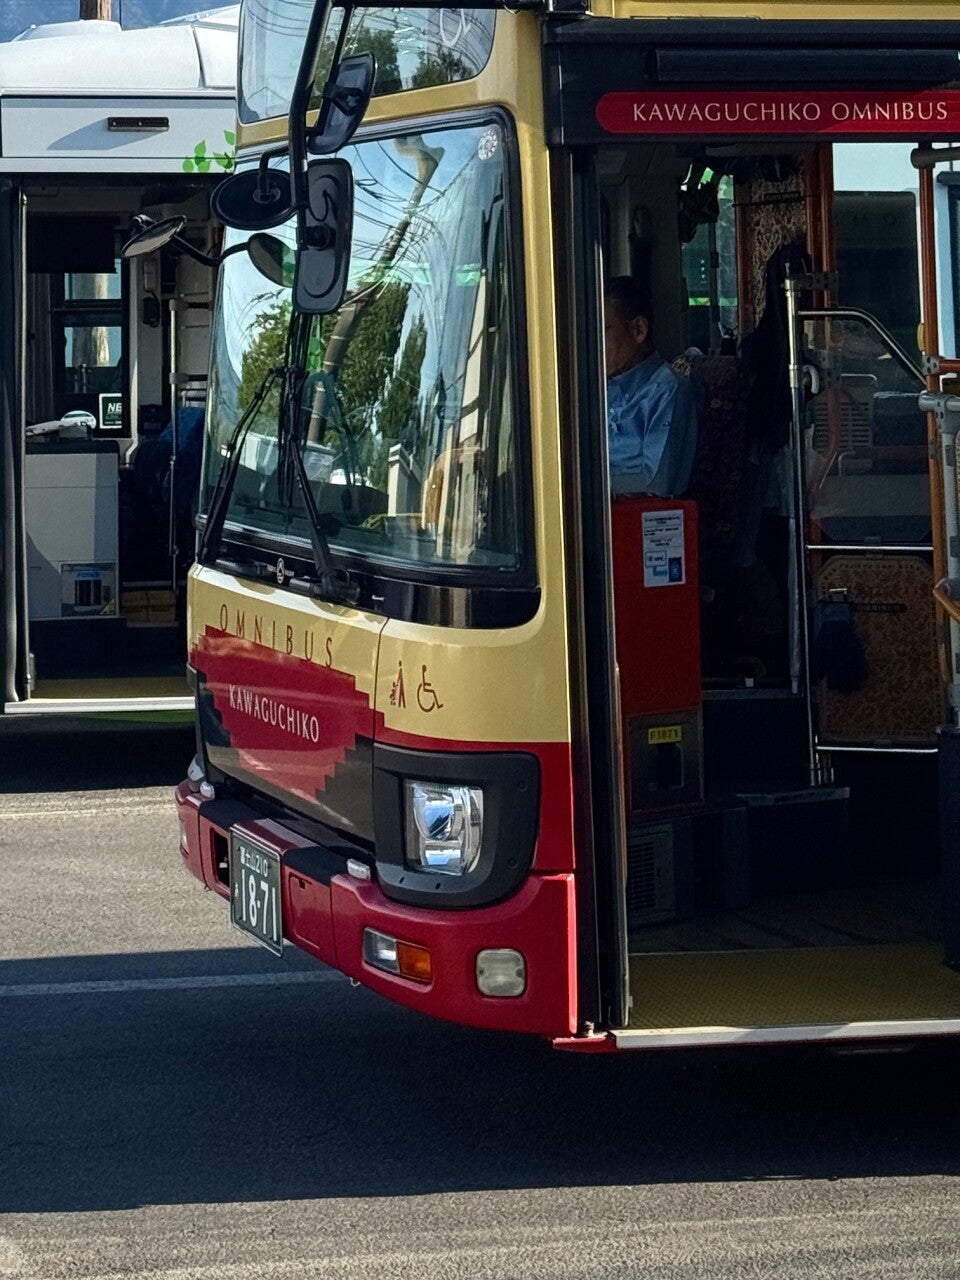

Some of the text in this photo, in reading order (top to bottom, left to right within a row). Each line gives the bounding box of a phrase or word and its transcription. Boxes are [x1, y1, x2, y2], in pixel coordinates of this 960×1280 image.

[633, 101, 948, 122] KAWAGUCHIKO OMNIBUS
[220, 603, 332, 668] OMNIBUS
[229, 683, 319, 743] KAWAGUCHIKO
